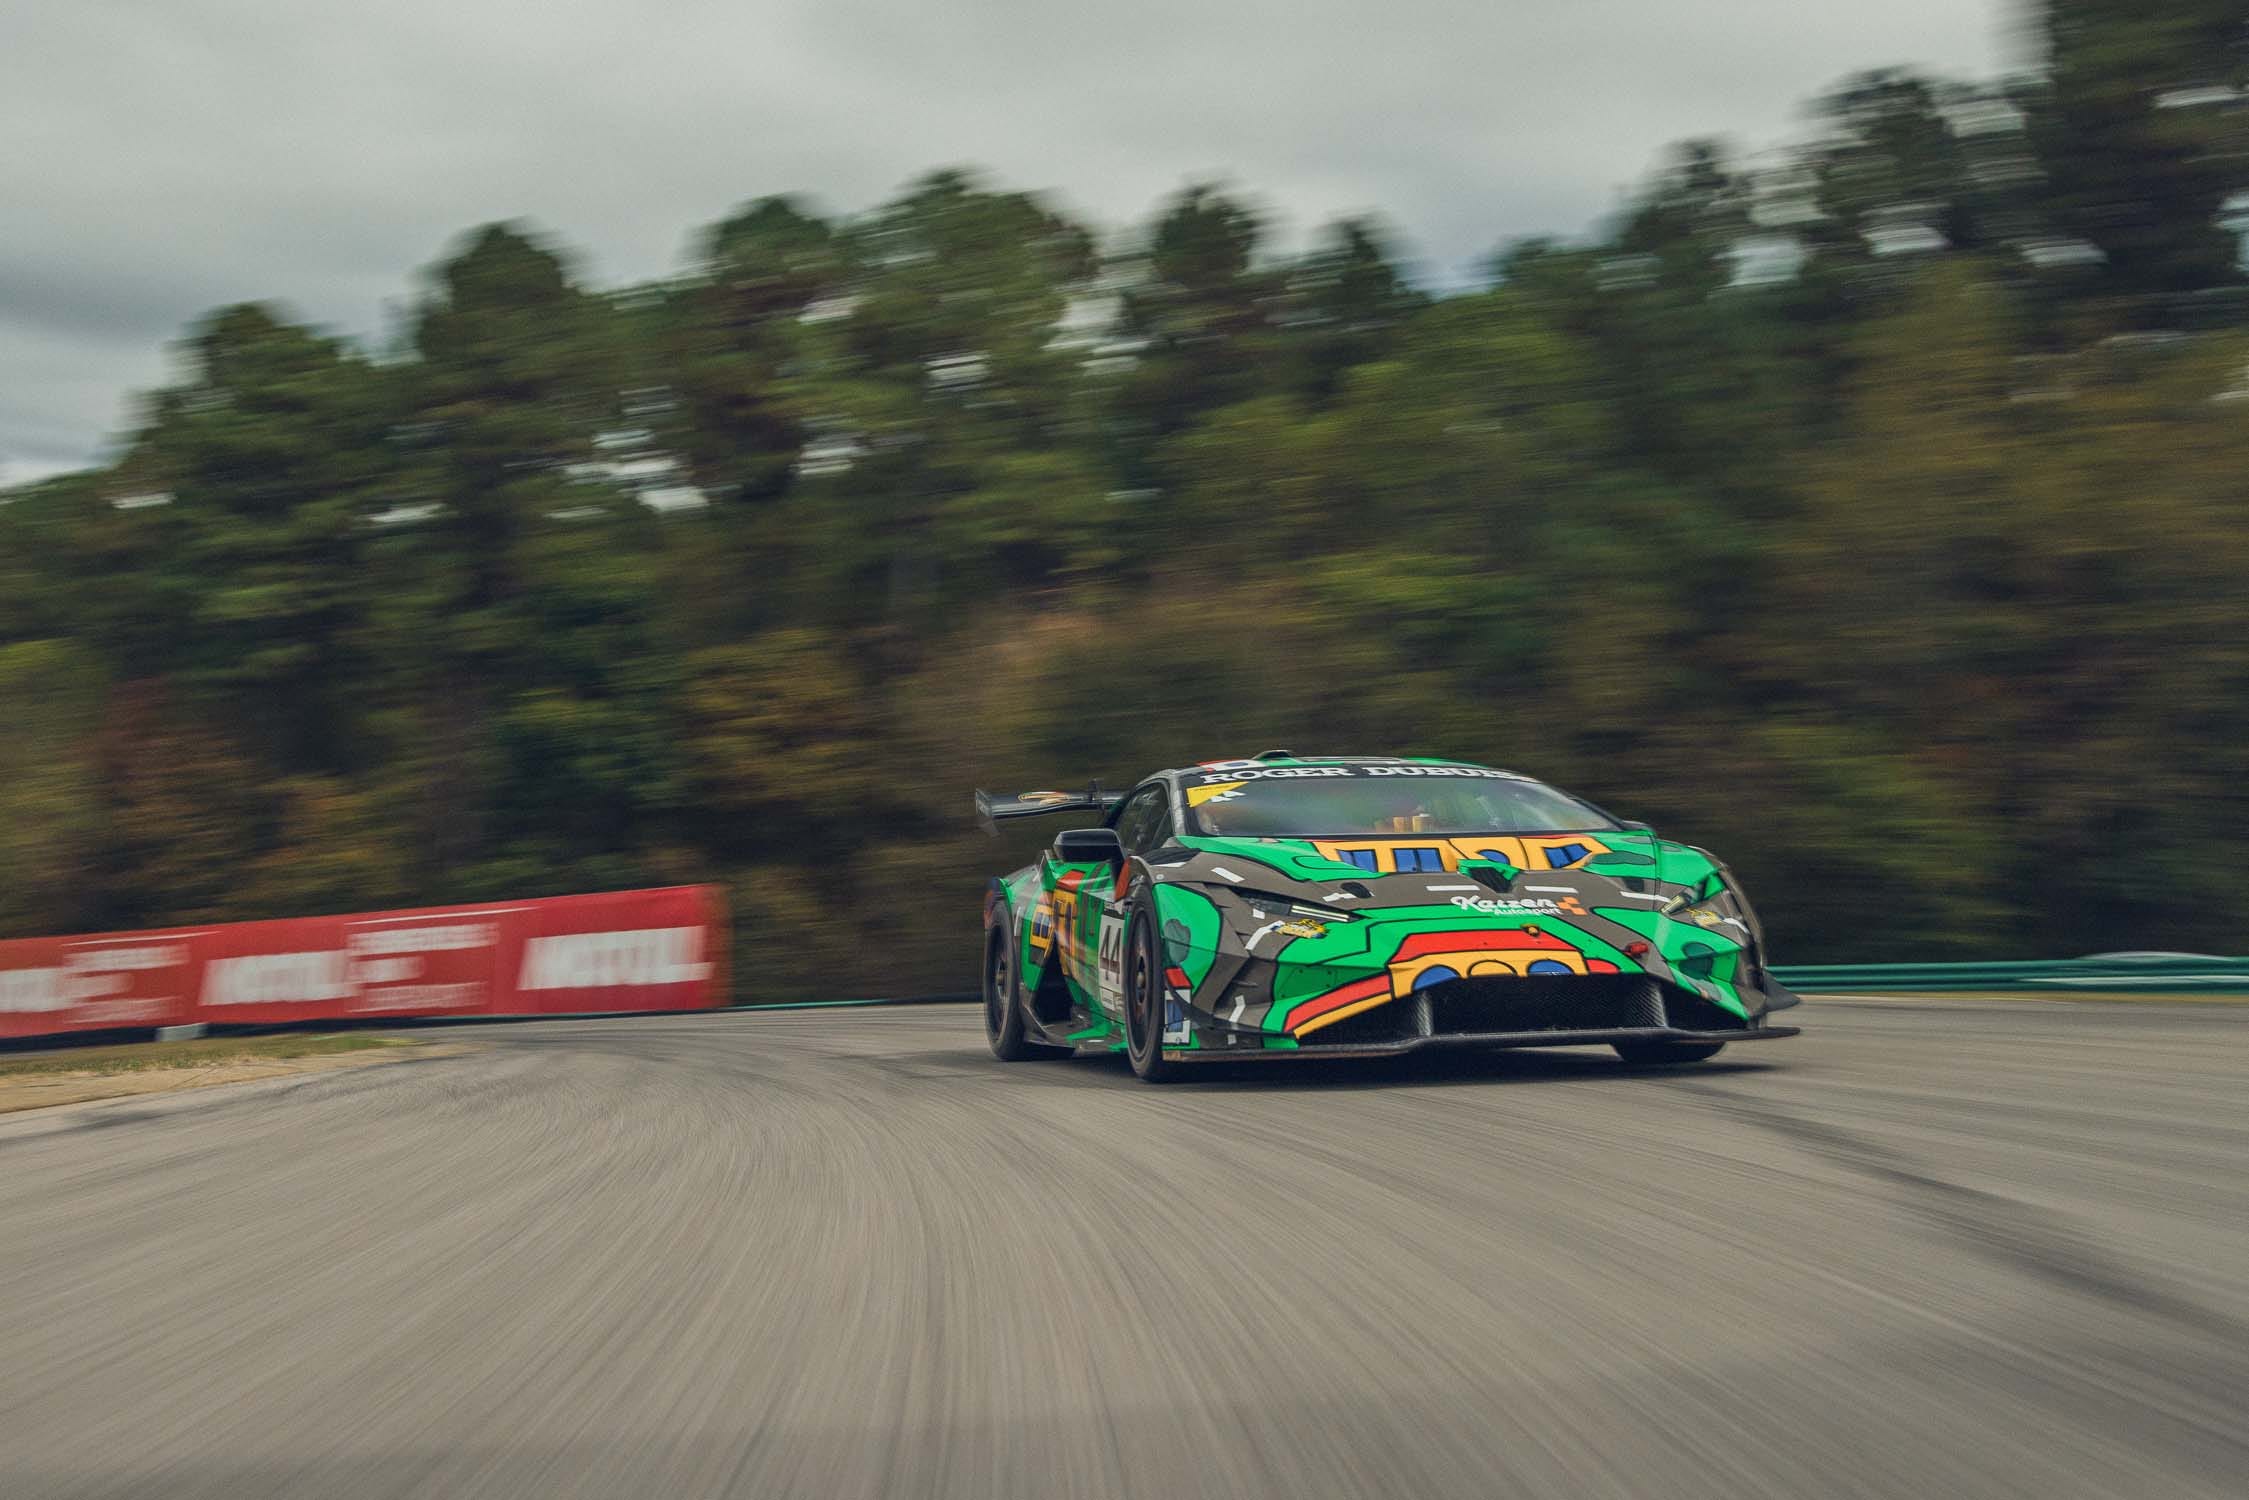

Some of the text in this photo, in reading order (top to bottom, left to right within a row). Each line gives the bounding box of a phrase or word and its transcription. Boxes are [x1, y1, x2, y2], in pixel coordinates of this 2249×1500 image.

[1201, 767, 1355, 784] ROGER
[1450, 895, 1557, 913] Kaizen
[1493, 907, 1563, 917] Autosport
[1100, 925, 1122, 984] 44
